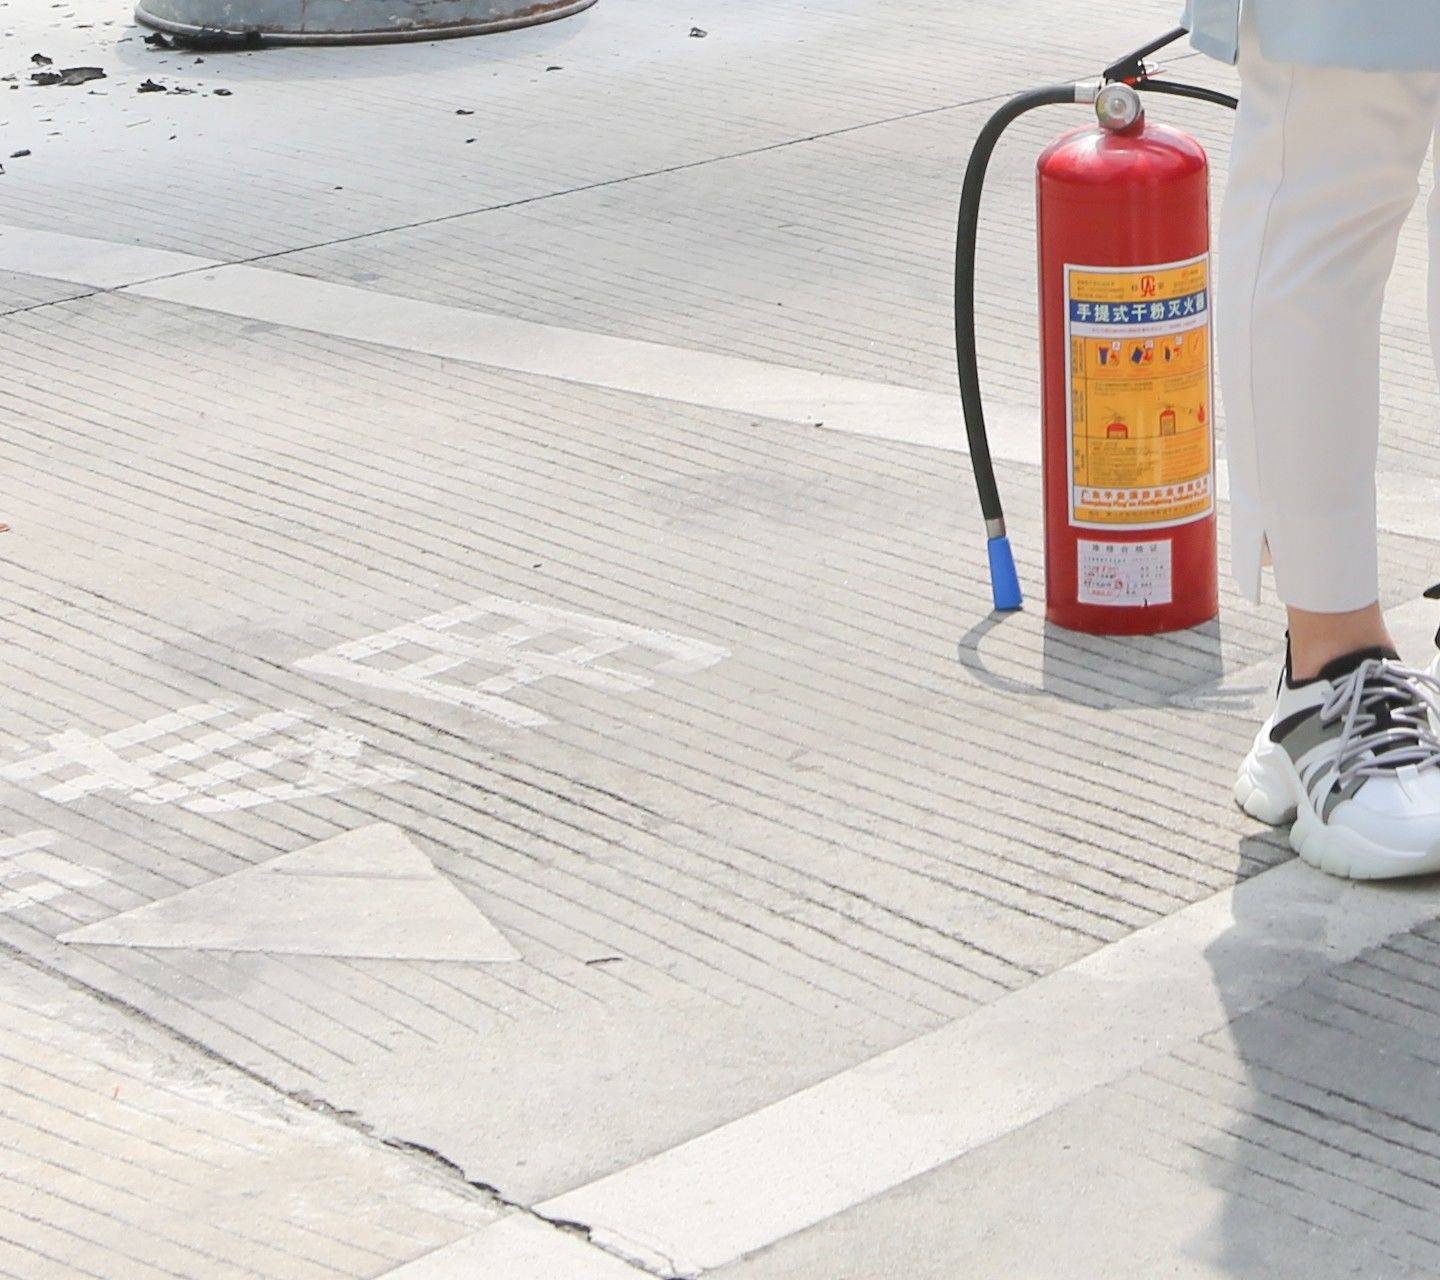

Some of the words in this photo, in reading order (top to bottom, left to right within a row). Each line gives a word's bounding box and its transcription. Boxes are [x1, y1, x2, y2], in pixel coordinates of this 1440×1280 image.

[1076, 294, 1206, 323] 手提式干粉灭火器
